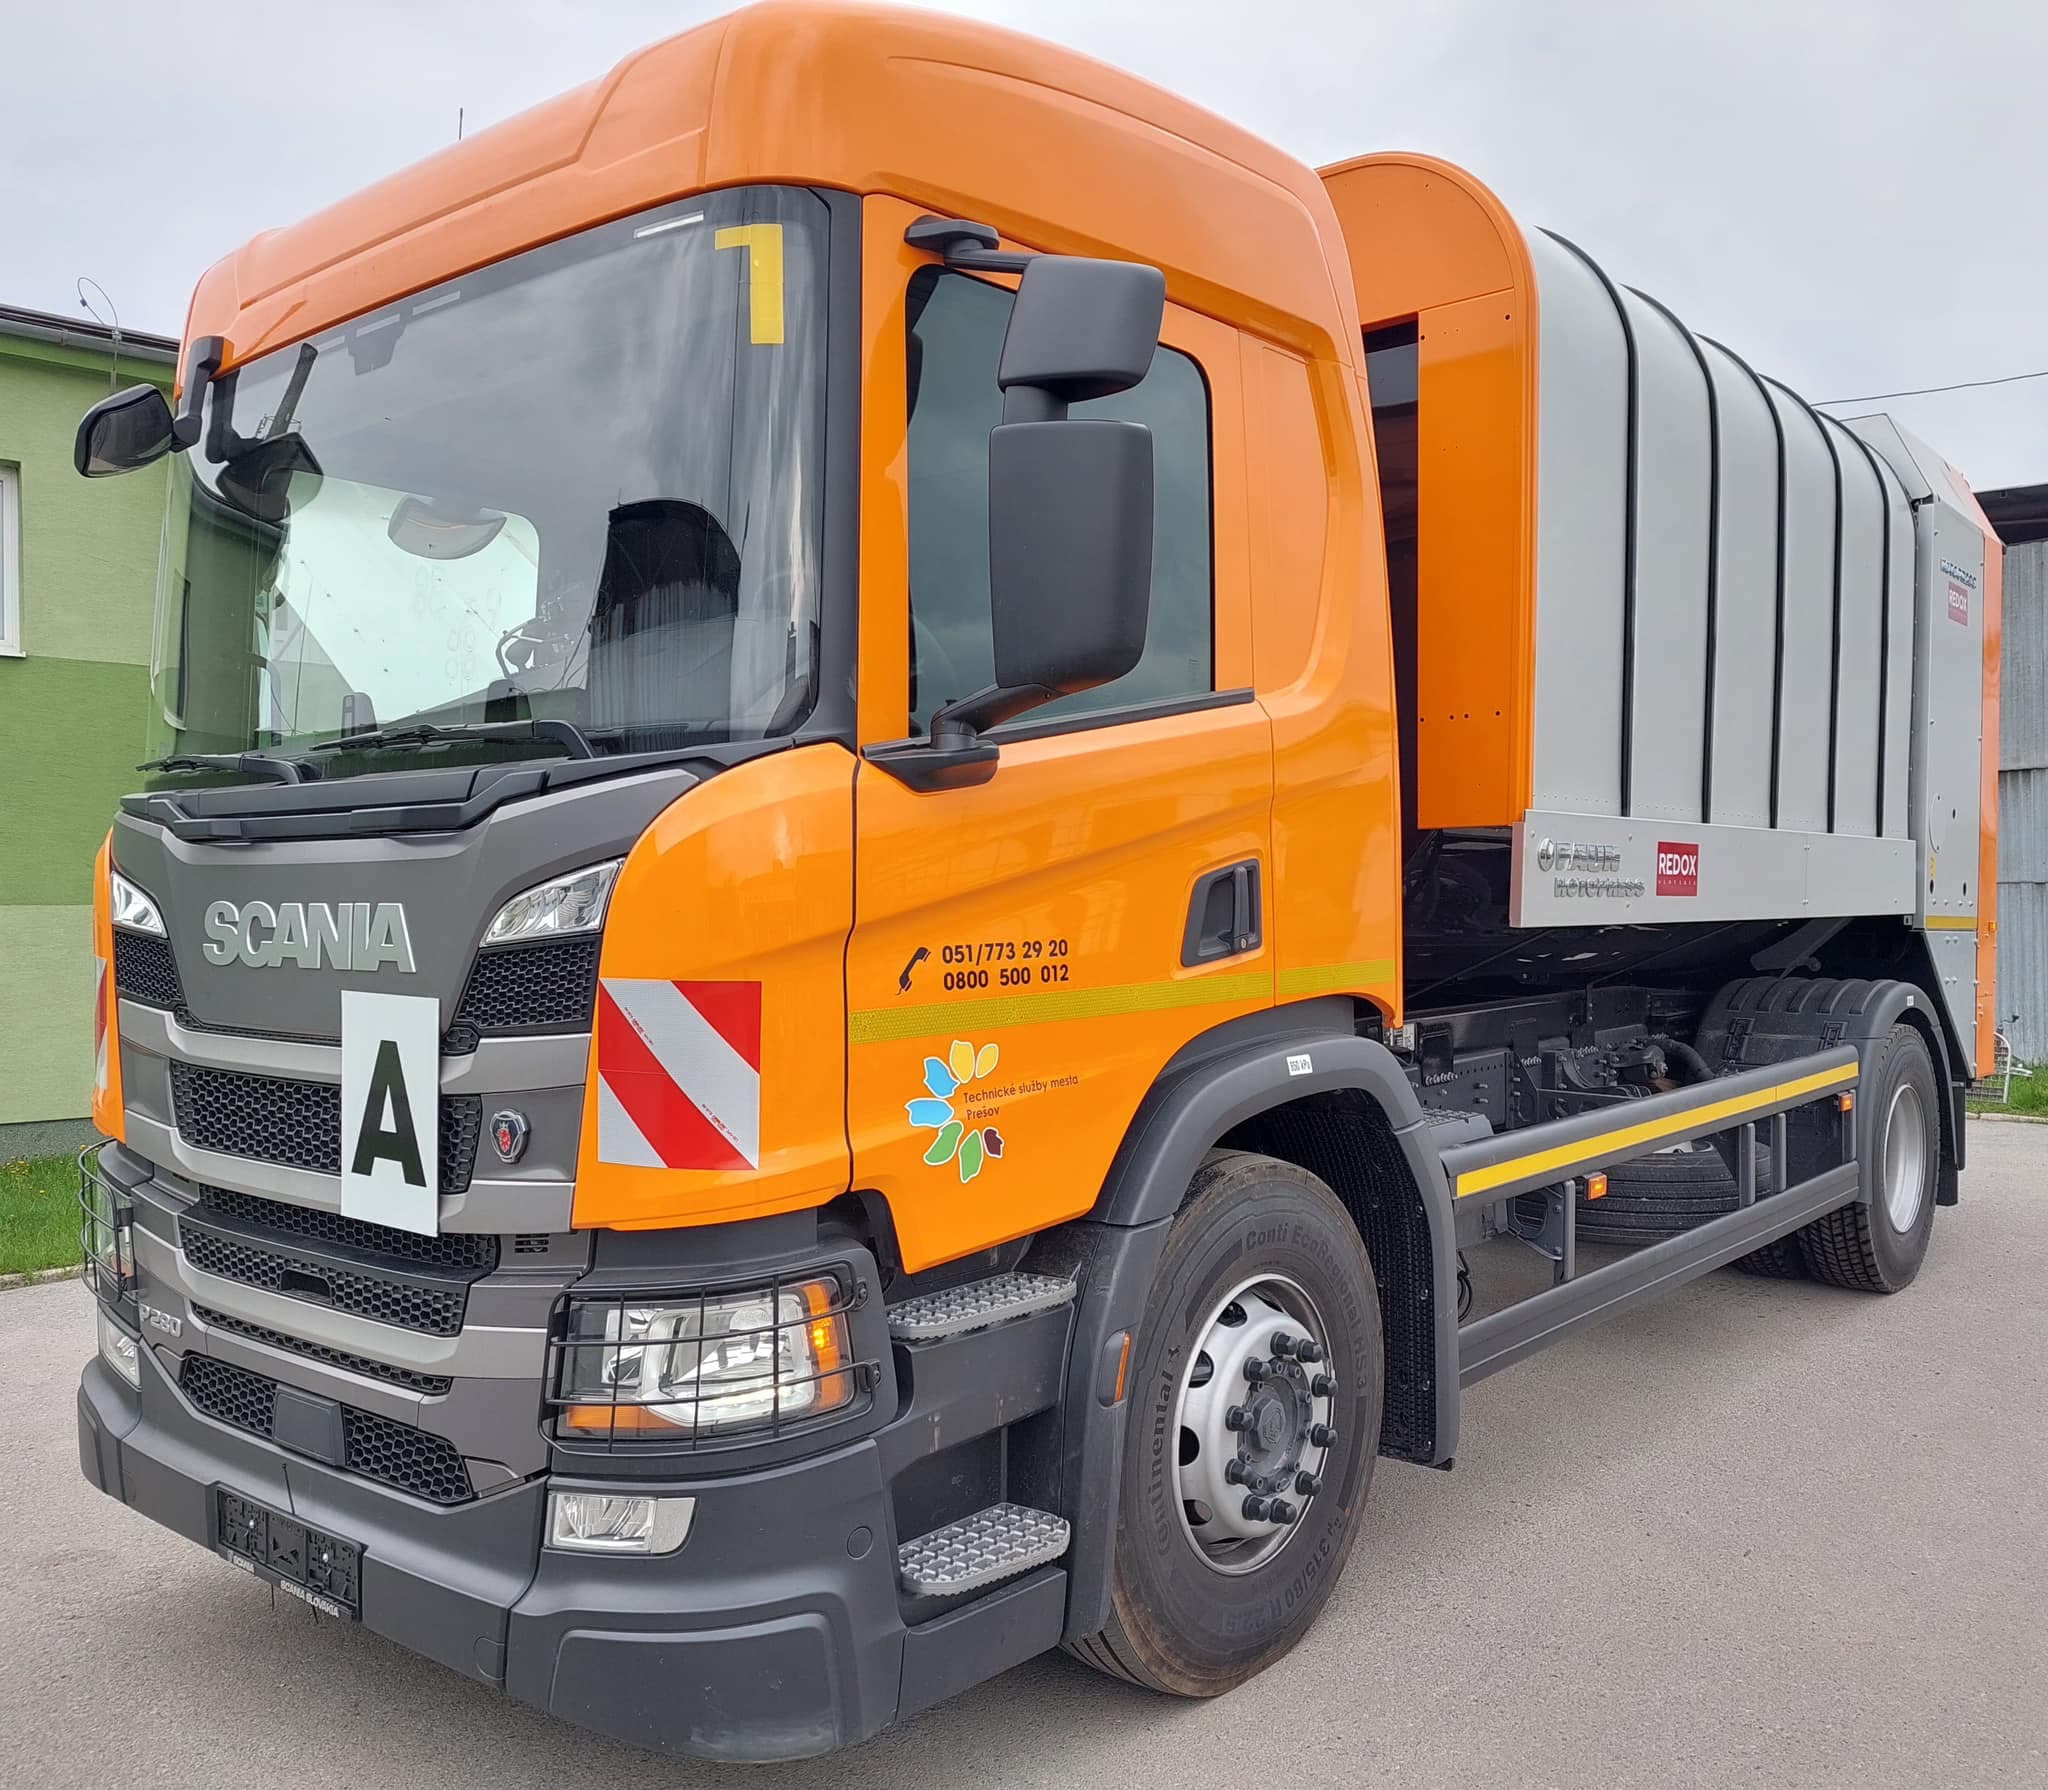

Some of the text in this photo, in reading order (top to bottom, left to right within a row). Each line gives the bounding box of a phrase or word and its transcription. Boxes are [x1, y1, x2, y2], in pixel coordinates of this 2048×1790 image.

[1658, 853, 1697, 876] REDOX
[202, 900, 417, 973] SCANIA
[942, 939, 1068, 966] 051/773 29 20
[944, 964, 1069, 991] 0800 500 012
[963, 1075, 1079, 1104] Technické služby mesta
[351, 1039, 427, 1188] A
[966, 1105, 1000, 1121] Prešov
